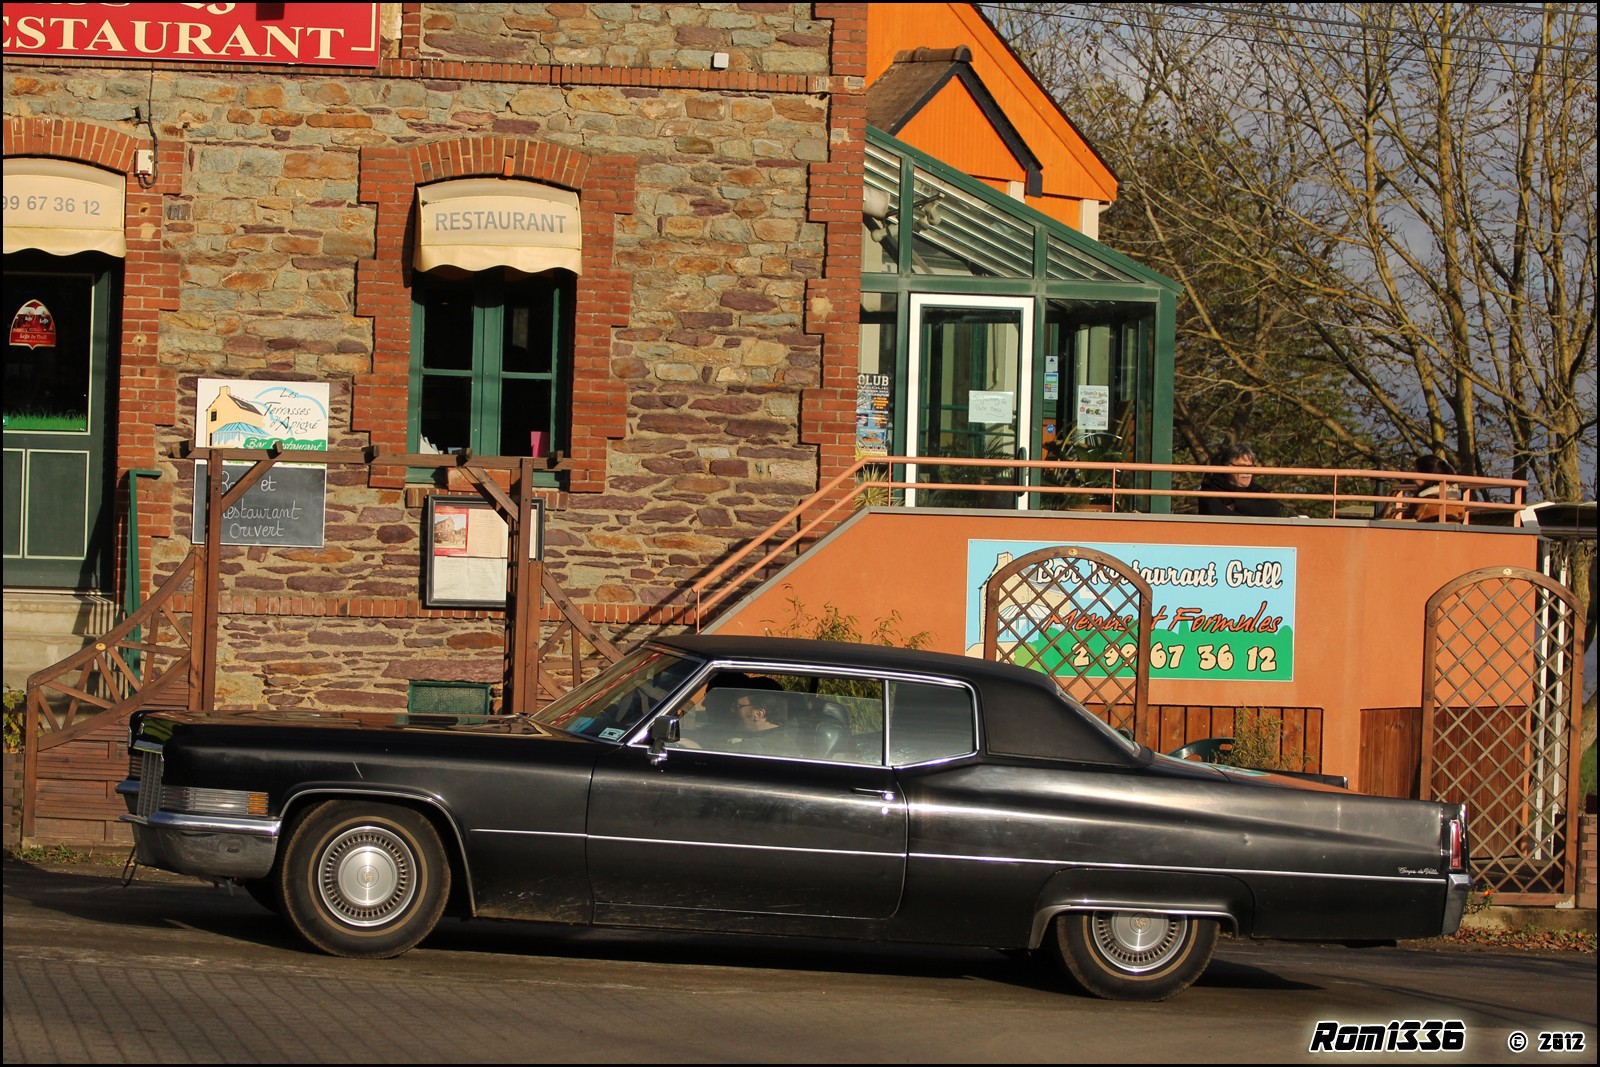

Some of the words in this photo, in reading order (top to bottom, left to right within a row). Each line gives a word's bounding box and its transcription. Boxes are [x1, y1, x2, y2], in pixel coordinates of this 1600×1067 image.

[27, 195, 48, 211] 67
[53, 196, 76, 212] 36
[82, 199, 100, 216] 12
[435, 211, 567, 233] RESTAURANT
[857, 374, 889, 387] CLUB
[279, 387, 299, 399] Les
[263, 401, 311, 417] Terrasses
[246, 438, 267, 449] Bar
[260, 475, 277, 492] et
[222, 498, 302, 520] estaurant
[229, 520, 285, 539] Ouvert
[1036, 558, 1084, 584] Bar
[1225, 559, 1284, 589] Grill
[1042, 608, 1134, 634] Menus
[1150, 604, 1169, 632] t
[1167, 600, 1284, 634] Formules
[1071, 641, 1092, 668] 2
[1150, 641, 1186, 670] 67
[1197, 643, 1235, 672] 36
[1246, 645, 1278, 673] 12
